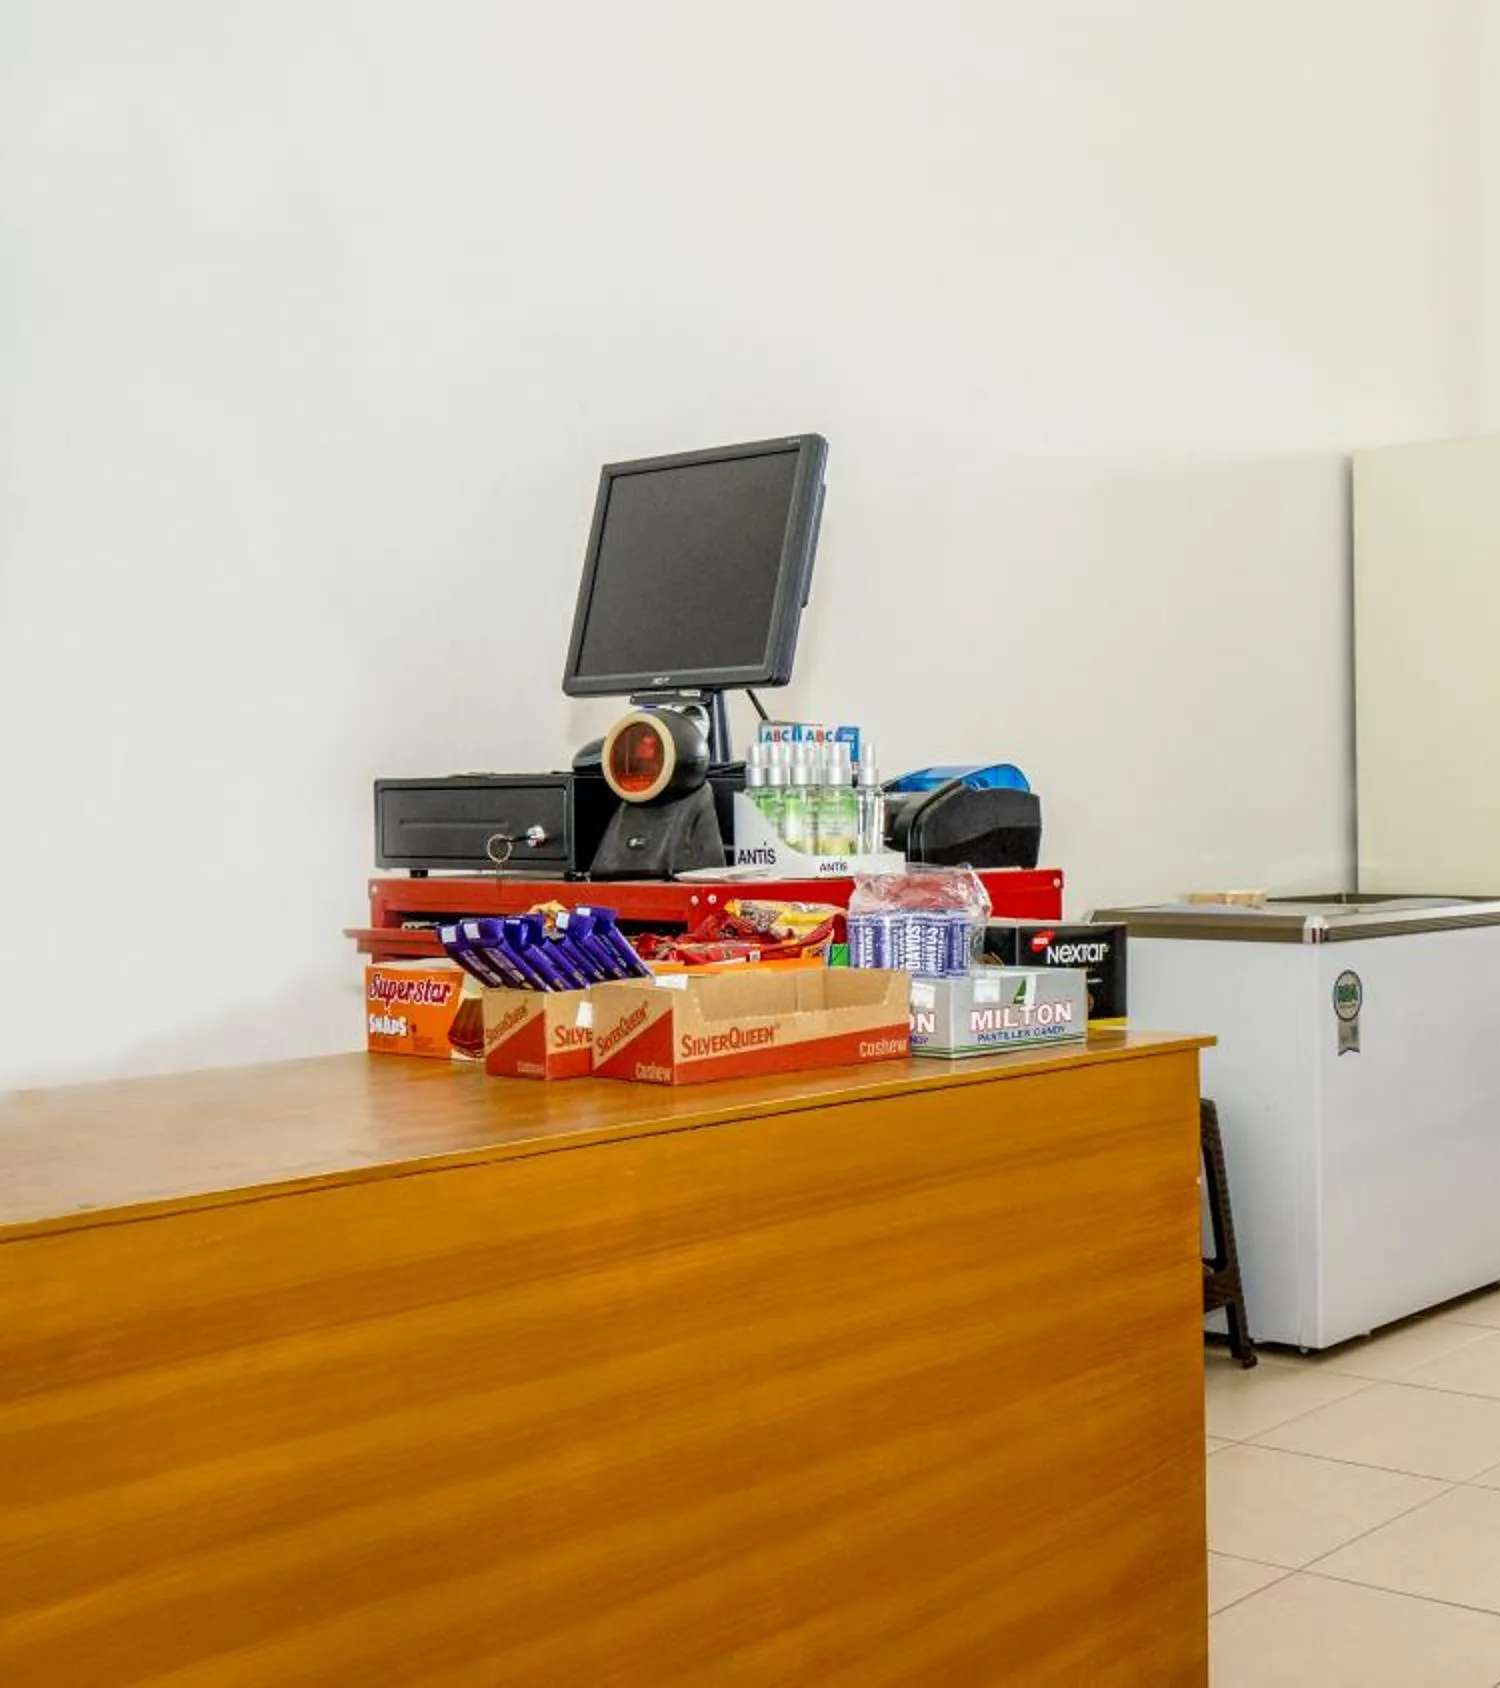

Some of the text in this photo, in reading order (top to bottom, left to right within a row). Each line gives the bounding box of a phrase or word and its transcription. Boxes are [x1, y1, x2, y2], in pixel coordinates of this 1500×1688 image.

[764, 729, 789, 742] ABC
[806, 729, 833, 742] ABC
[368, 973, 451, 1007] Superstar
[970, 1002, 1073, 1032] MILTON
